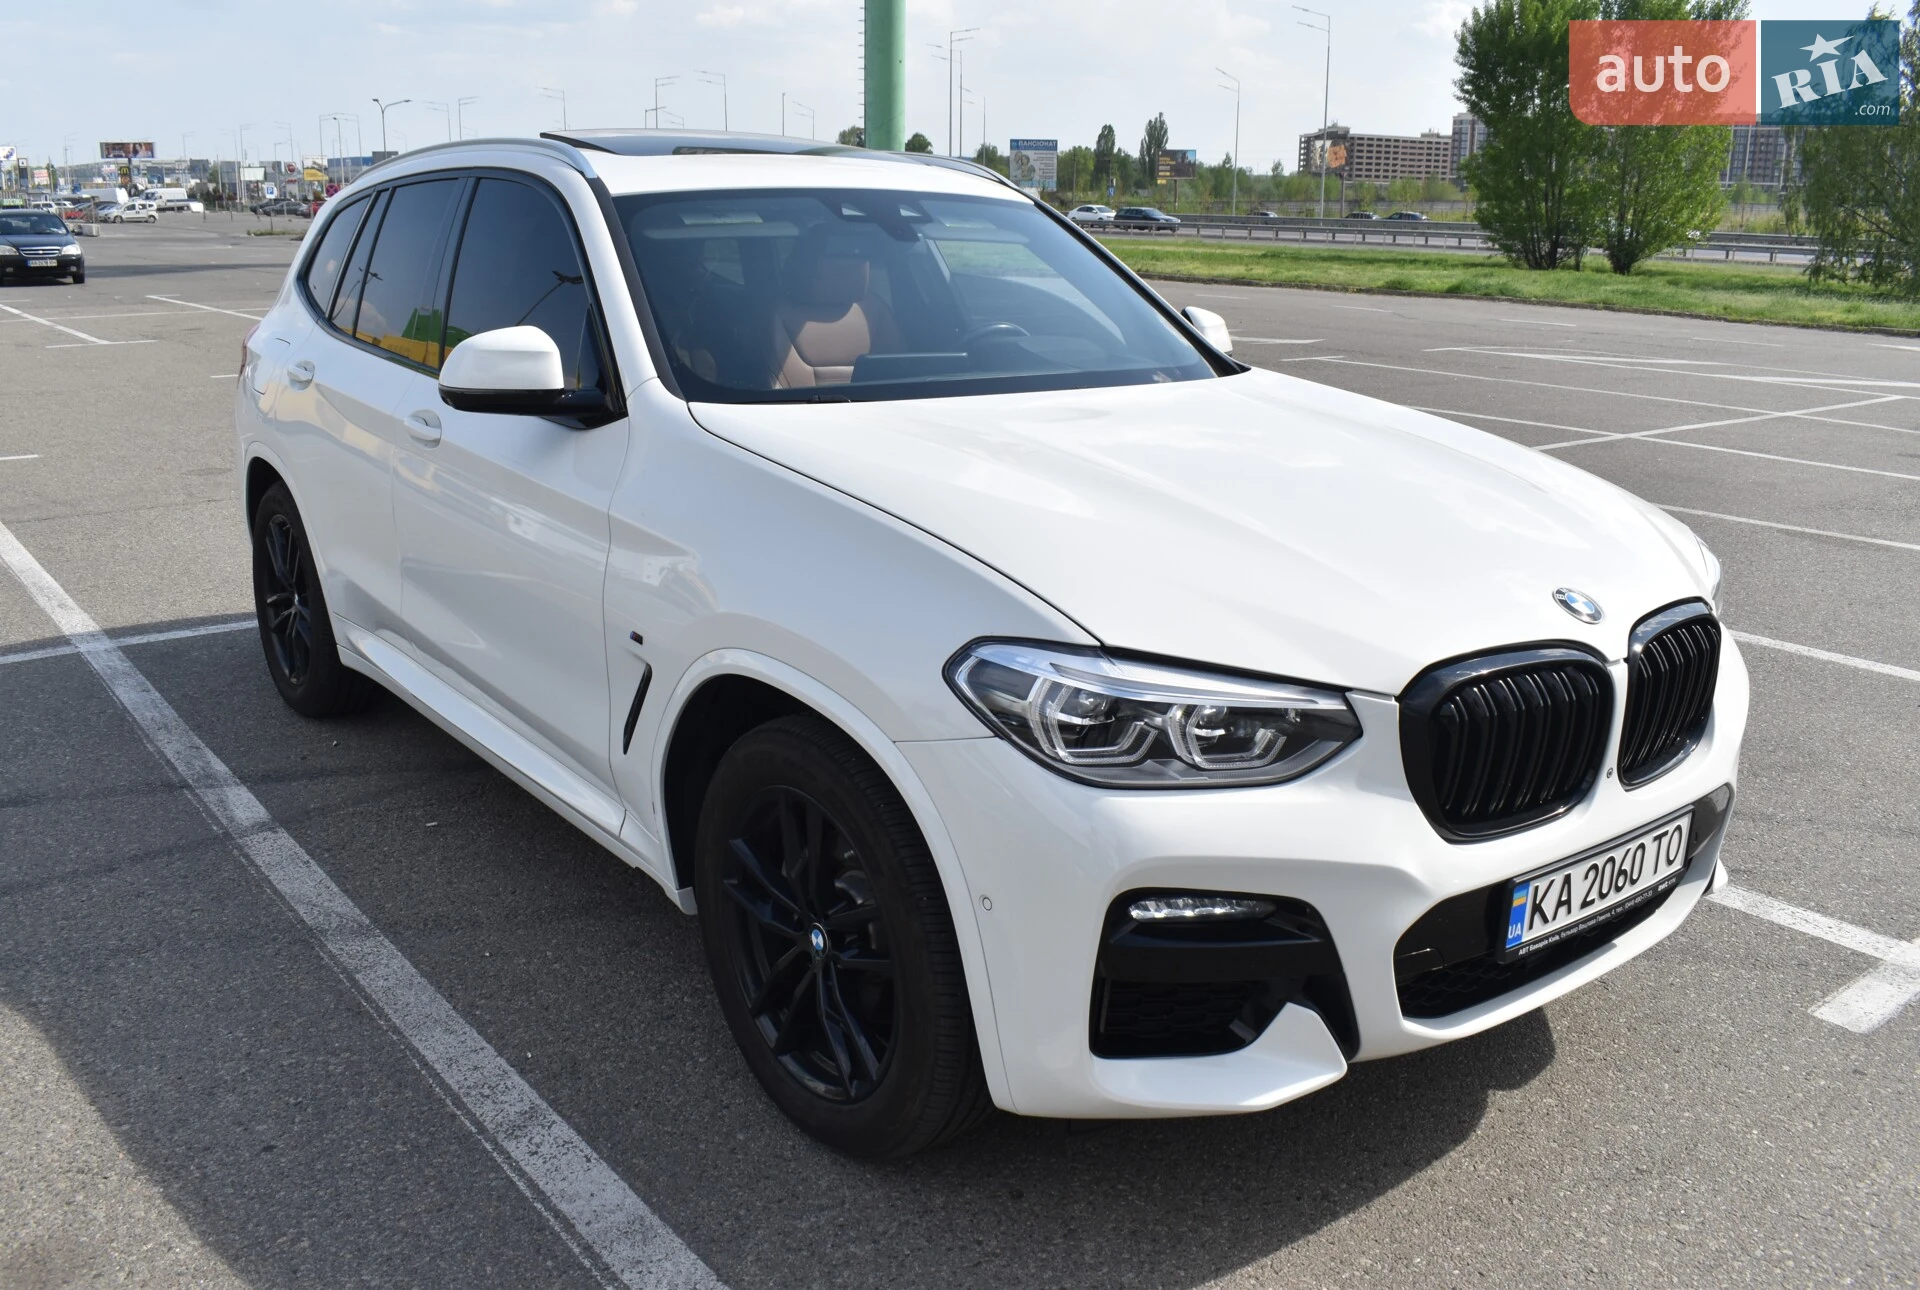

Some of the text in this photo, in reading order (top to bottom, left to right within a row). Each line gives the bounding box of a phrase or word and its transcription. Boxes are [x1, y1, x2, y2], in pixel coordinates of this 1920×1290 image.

[1528, 824, 1683, 931] KA 2060 TO
[1508, 922, 1522, 939] UA
